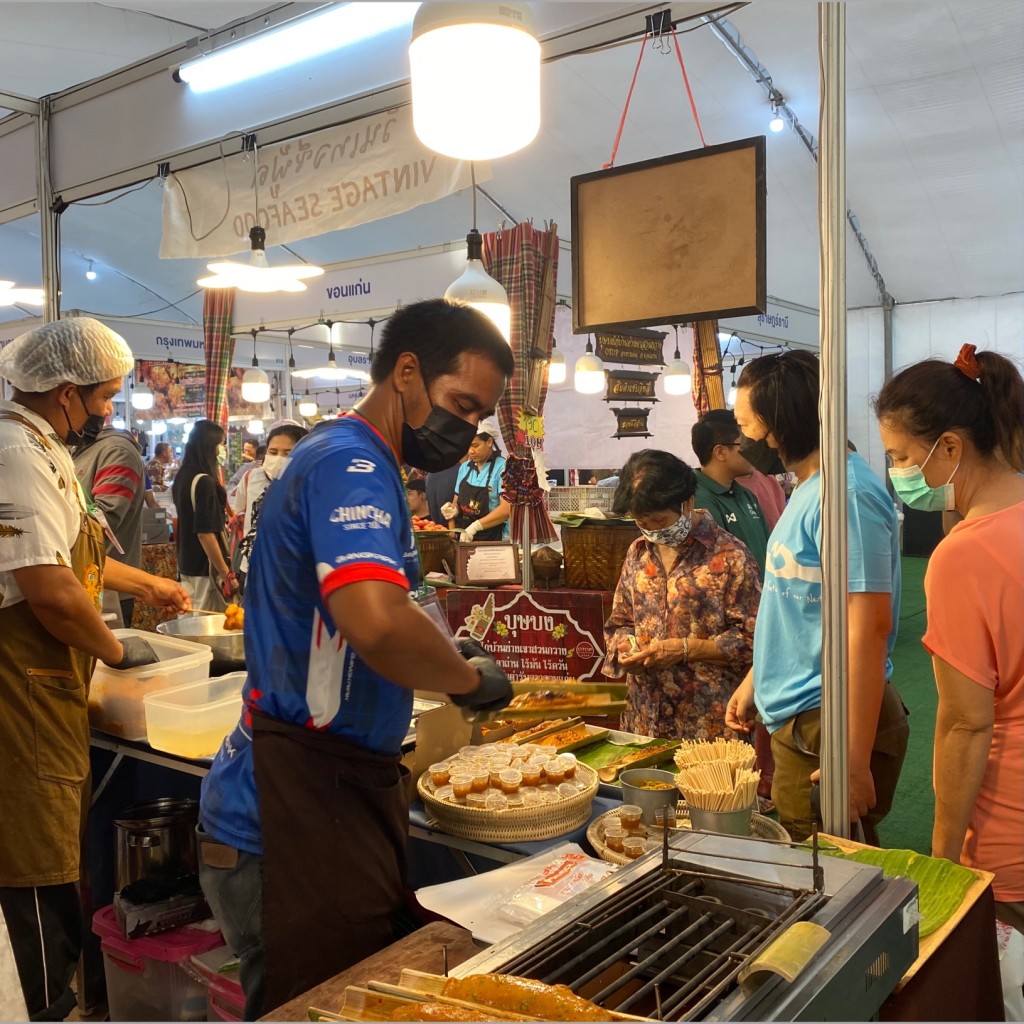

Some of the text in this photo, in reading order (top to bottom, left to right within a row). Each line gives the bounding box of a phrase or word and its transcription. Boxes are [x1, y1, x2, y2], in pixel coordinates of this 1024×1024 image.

[326, 278, 372, 300] ขอนแก่น
[155, 334, 206, 350] กรุงเทพม
